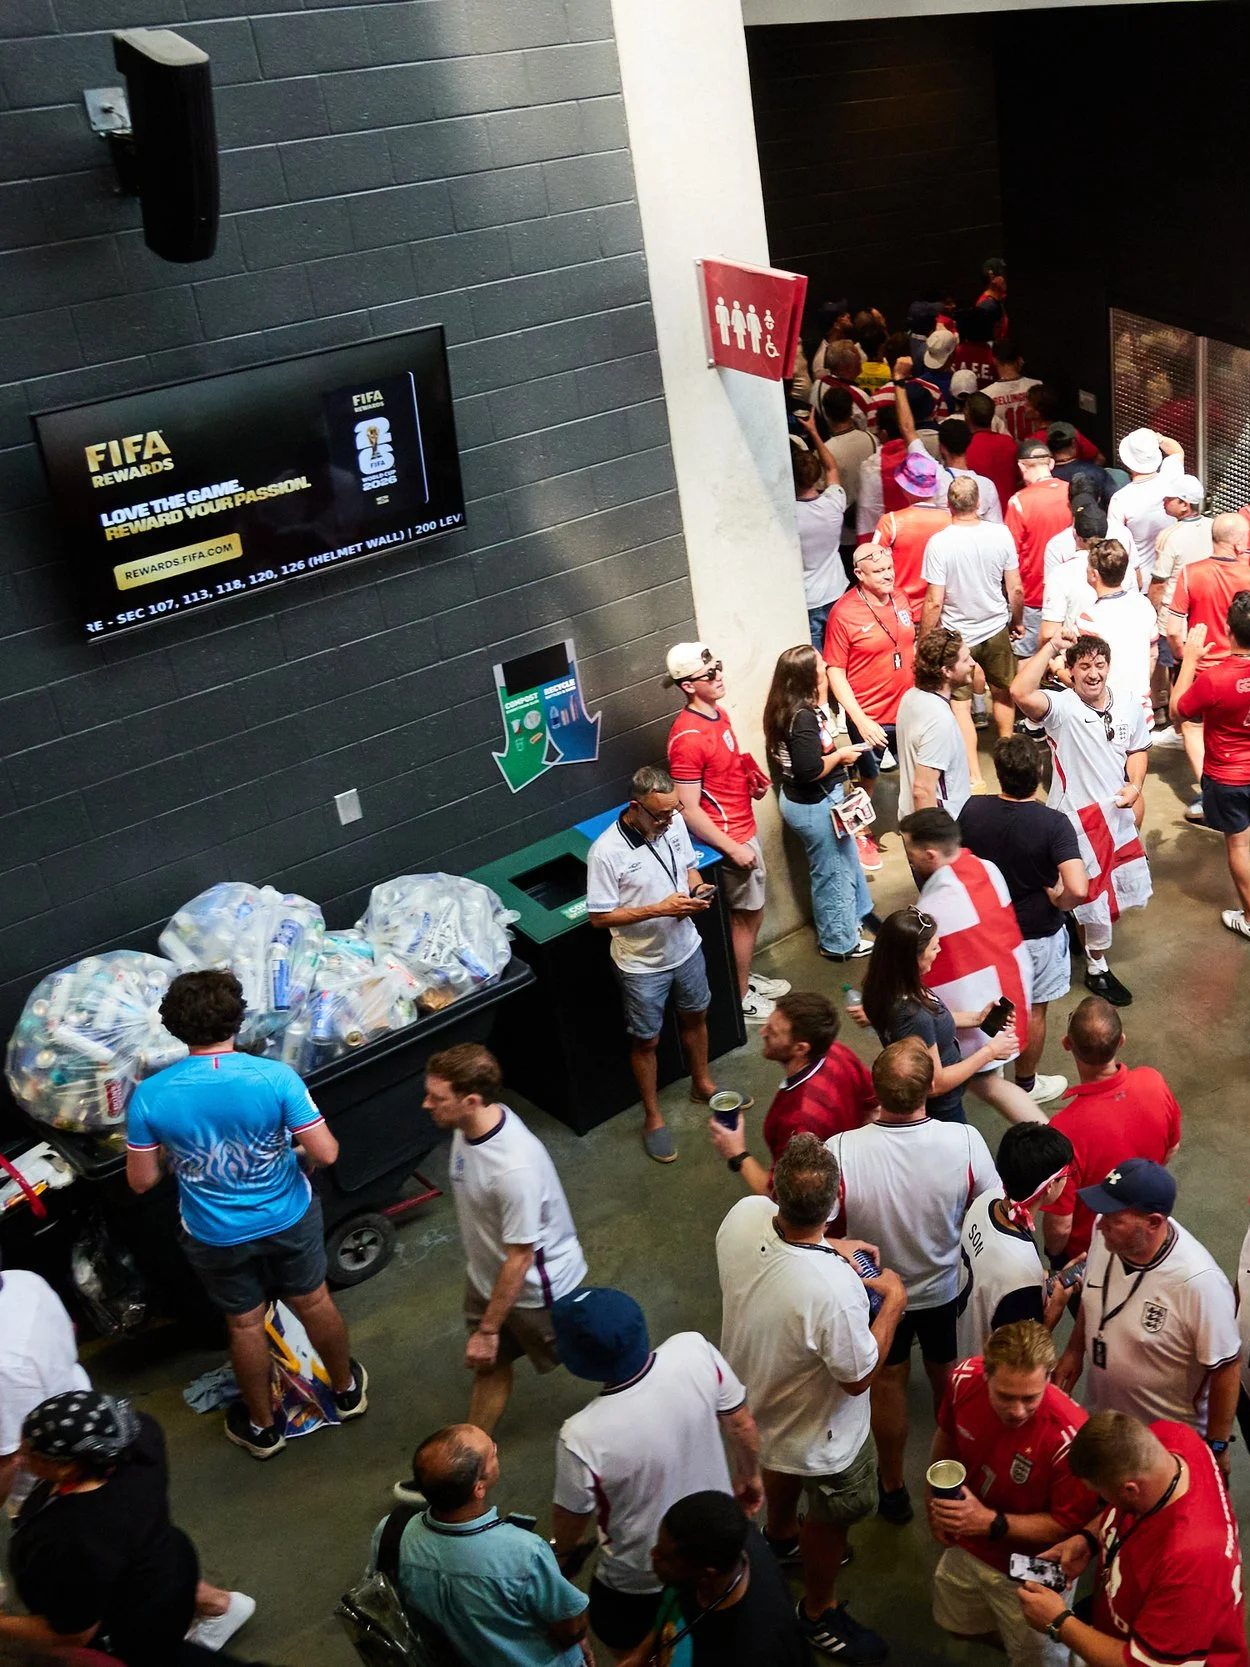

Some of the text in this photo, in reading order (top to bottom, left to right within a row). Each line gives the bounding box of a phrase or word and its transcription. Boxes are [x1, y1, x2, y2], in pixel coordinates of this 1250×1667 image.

[352, 390, 384, 406] FIFA
[993, 391, 1029, 407] BELLING
[85, 430, 171, 473] FIFA
[370, 460, 386, 469] FIFA
[92, 457, 174, 488] REWARDS
[362, 475, 398, 491] 2026
[101, 479, 244, 527] LOVE THE GAME.
[105, 476, 312, 541] REWARD YOUR PASSION.
[116, 608, 146, 625] SEC
[148, 599, 180, 615] 107,
[182, 589, 213, 605] 113,
[215, 579, 246, 595] 118,
[249, 569, 278, 585] 120,
[281, 560, 306, 575] 126
[308, 542, 364, 568] (HELMET
[365, 530, 405, 549] WALL)
[415, 521, 438, 535] 200
[439, 513, 464, 528] LEV
[125, 543, 234, 580] REWARDS.FIFA.COM
[505, 692, 539, 710] COMPOST
[968, 1223, 984, 1258] SON
